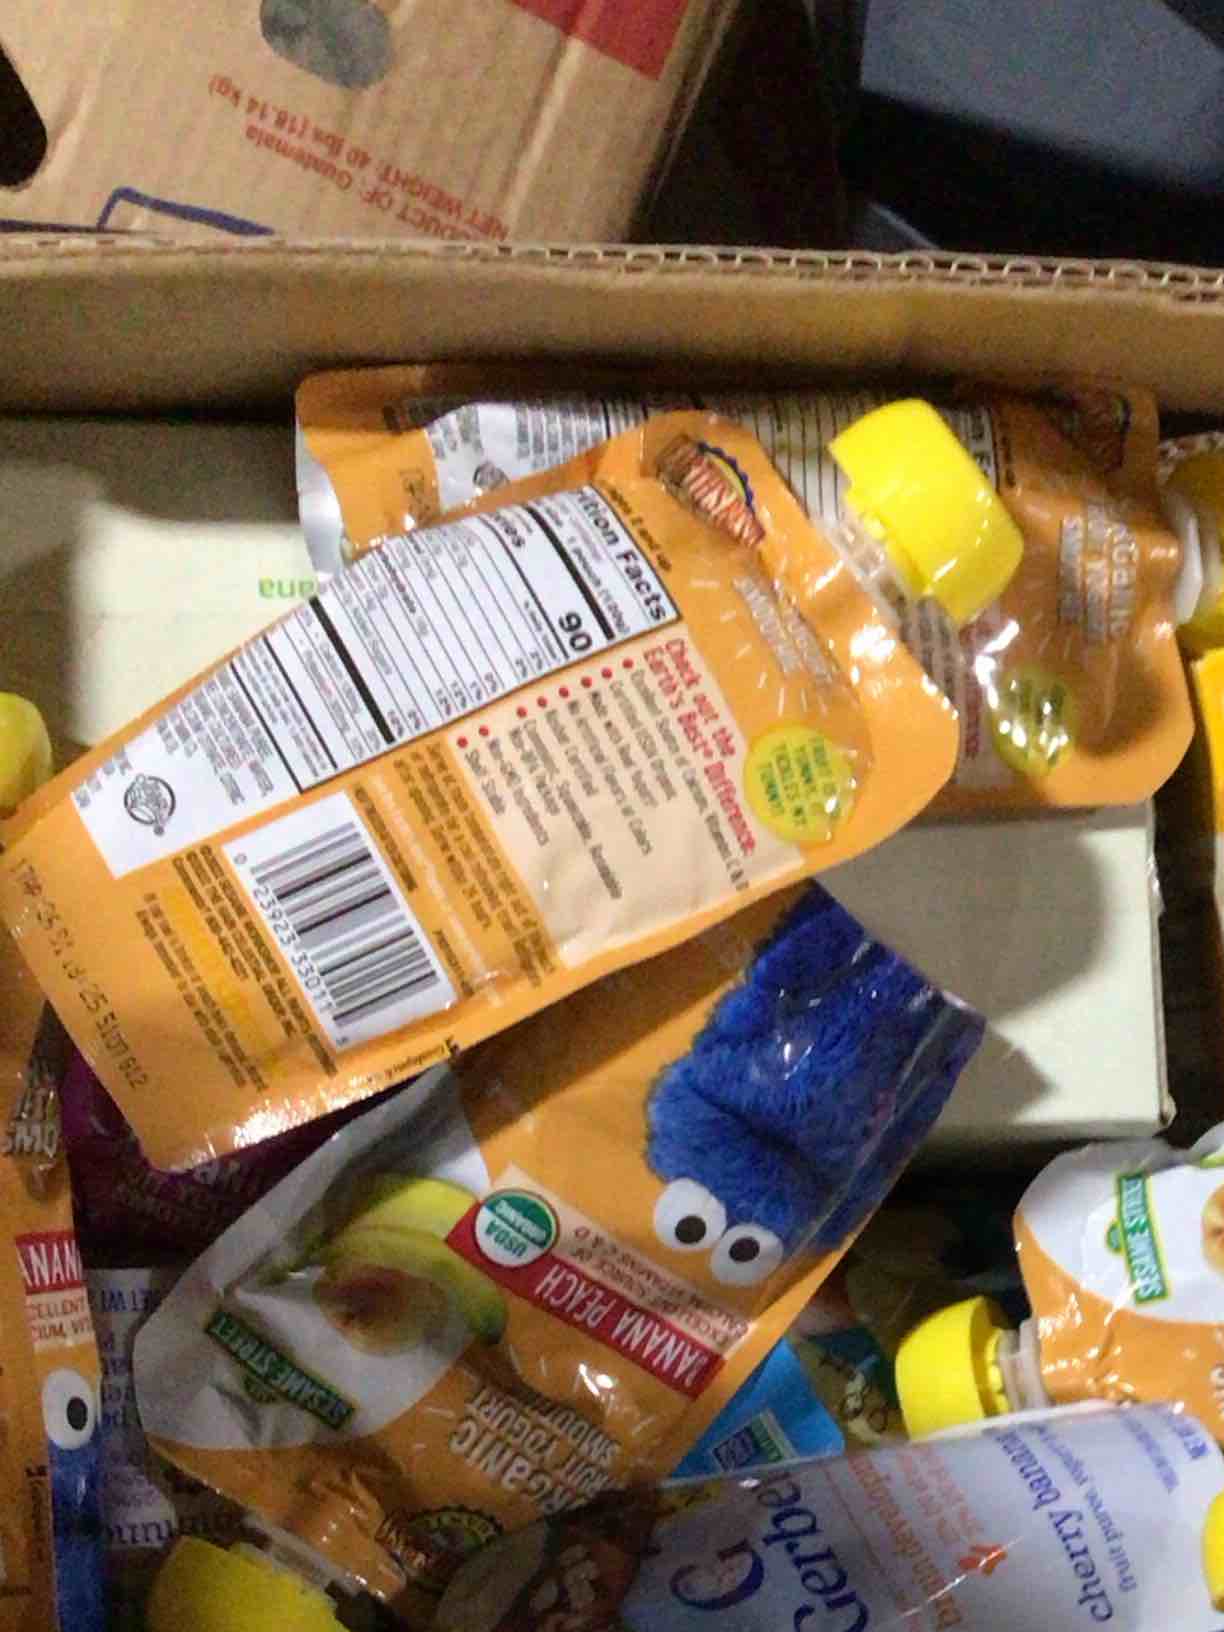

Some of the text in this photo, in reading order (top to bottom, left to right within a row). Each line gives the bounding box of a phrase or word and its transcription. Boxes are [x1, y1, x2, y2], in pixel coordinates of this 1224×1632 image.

[241, 123, 358, 194] Guatemala
[343, 145, 374, 174] 40
[614, 547, 668, 625] Facts
[555, 608, 595, 656] 90
[643, 646, 685, 709] Earth's
[663, 637, 738, 759] Check out the
[252, 883, 298, 947] 23923
[489, 1227, 528, 1255] USDA
[1125, 1228, 1164, 1300] SESAME
[530, 1259, 616, 1332] PEACH
[270, 1357, 353, 1423] SESAME
[460, 1381, 565, 1461] YOGURT
[1053, 1515, 1112, 1623] cherry
[1110, 1545, 1138, 1592] fruit
